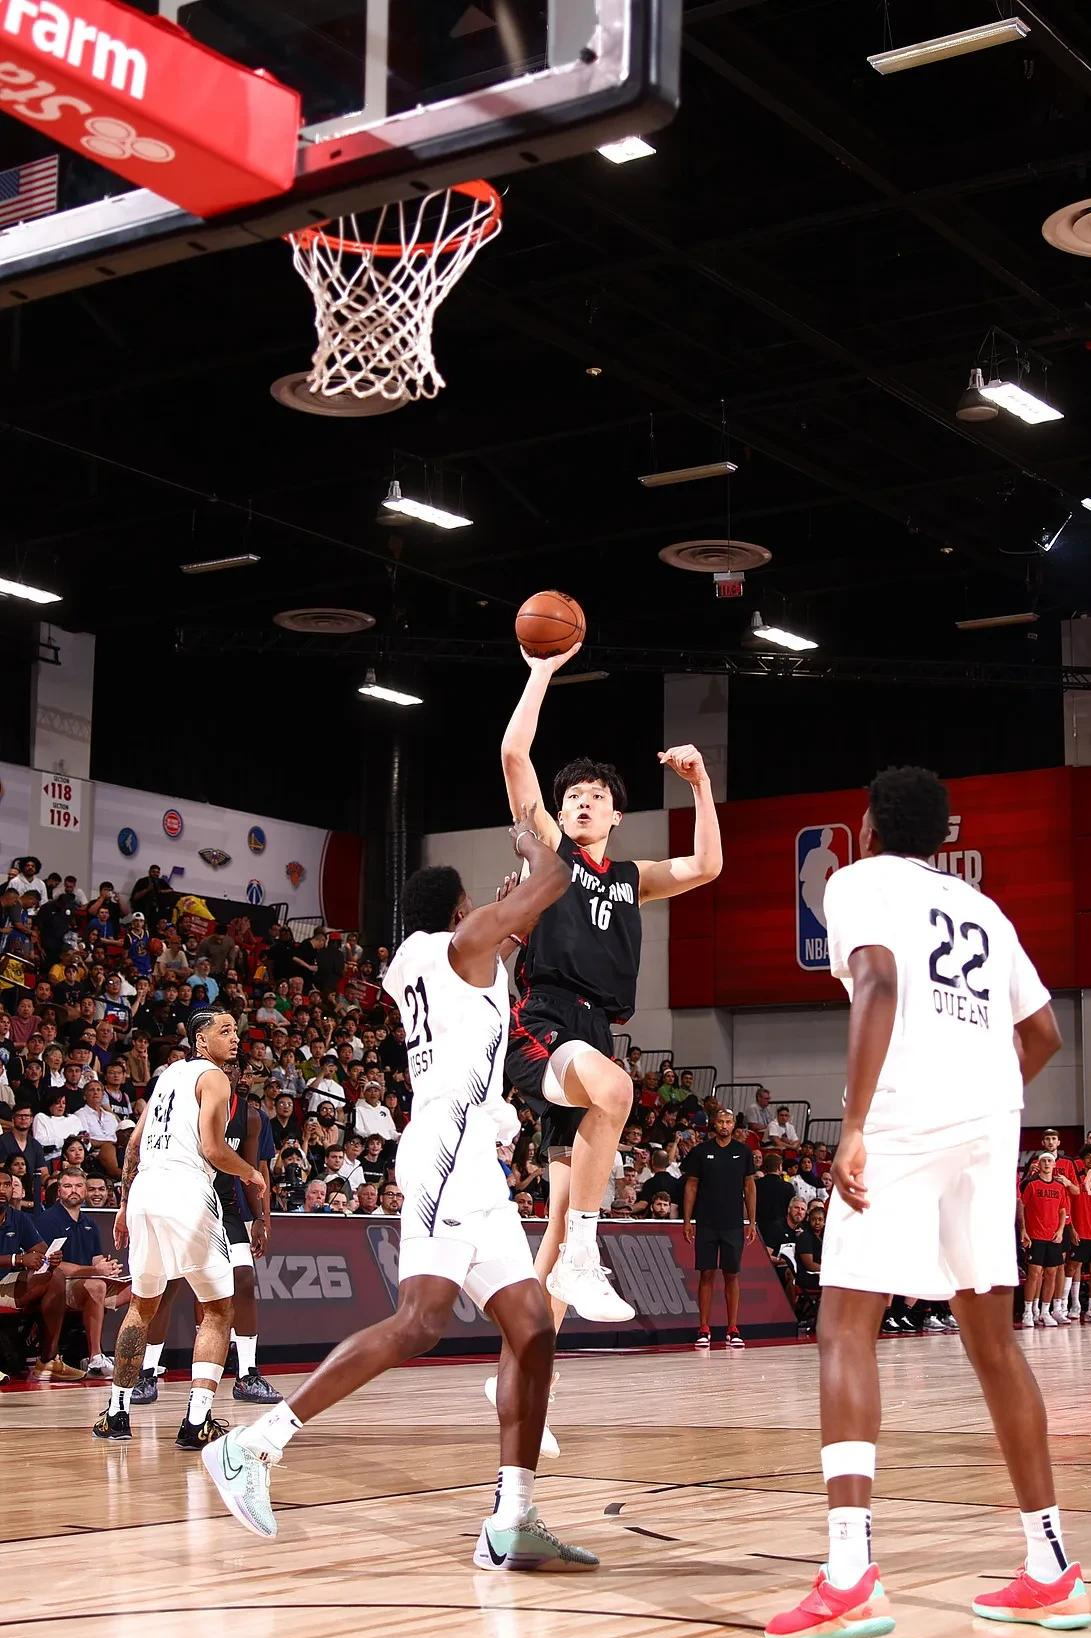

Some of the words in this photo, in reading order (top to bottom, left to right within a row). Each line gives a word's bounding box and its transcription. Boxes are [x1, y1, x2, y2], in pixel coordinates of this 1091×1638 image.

[51, 782, 72, 801] 118
[50, 808, 71, 828] 119
[589, 896, 613, 931] 16
[805, 937, 830, 961] NBA
[928, 908, 990, 1001] 22
[404, 976, 432, 1050] 21
[933, 988, 990, 1030] QUEEN
[254, 1255, 352, 1300] K26
